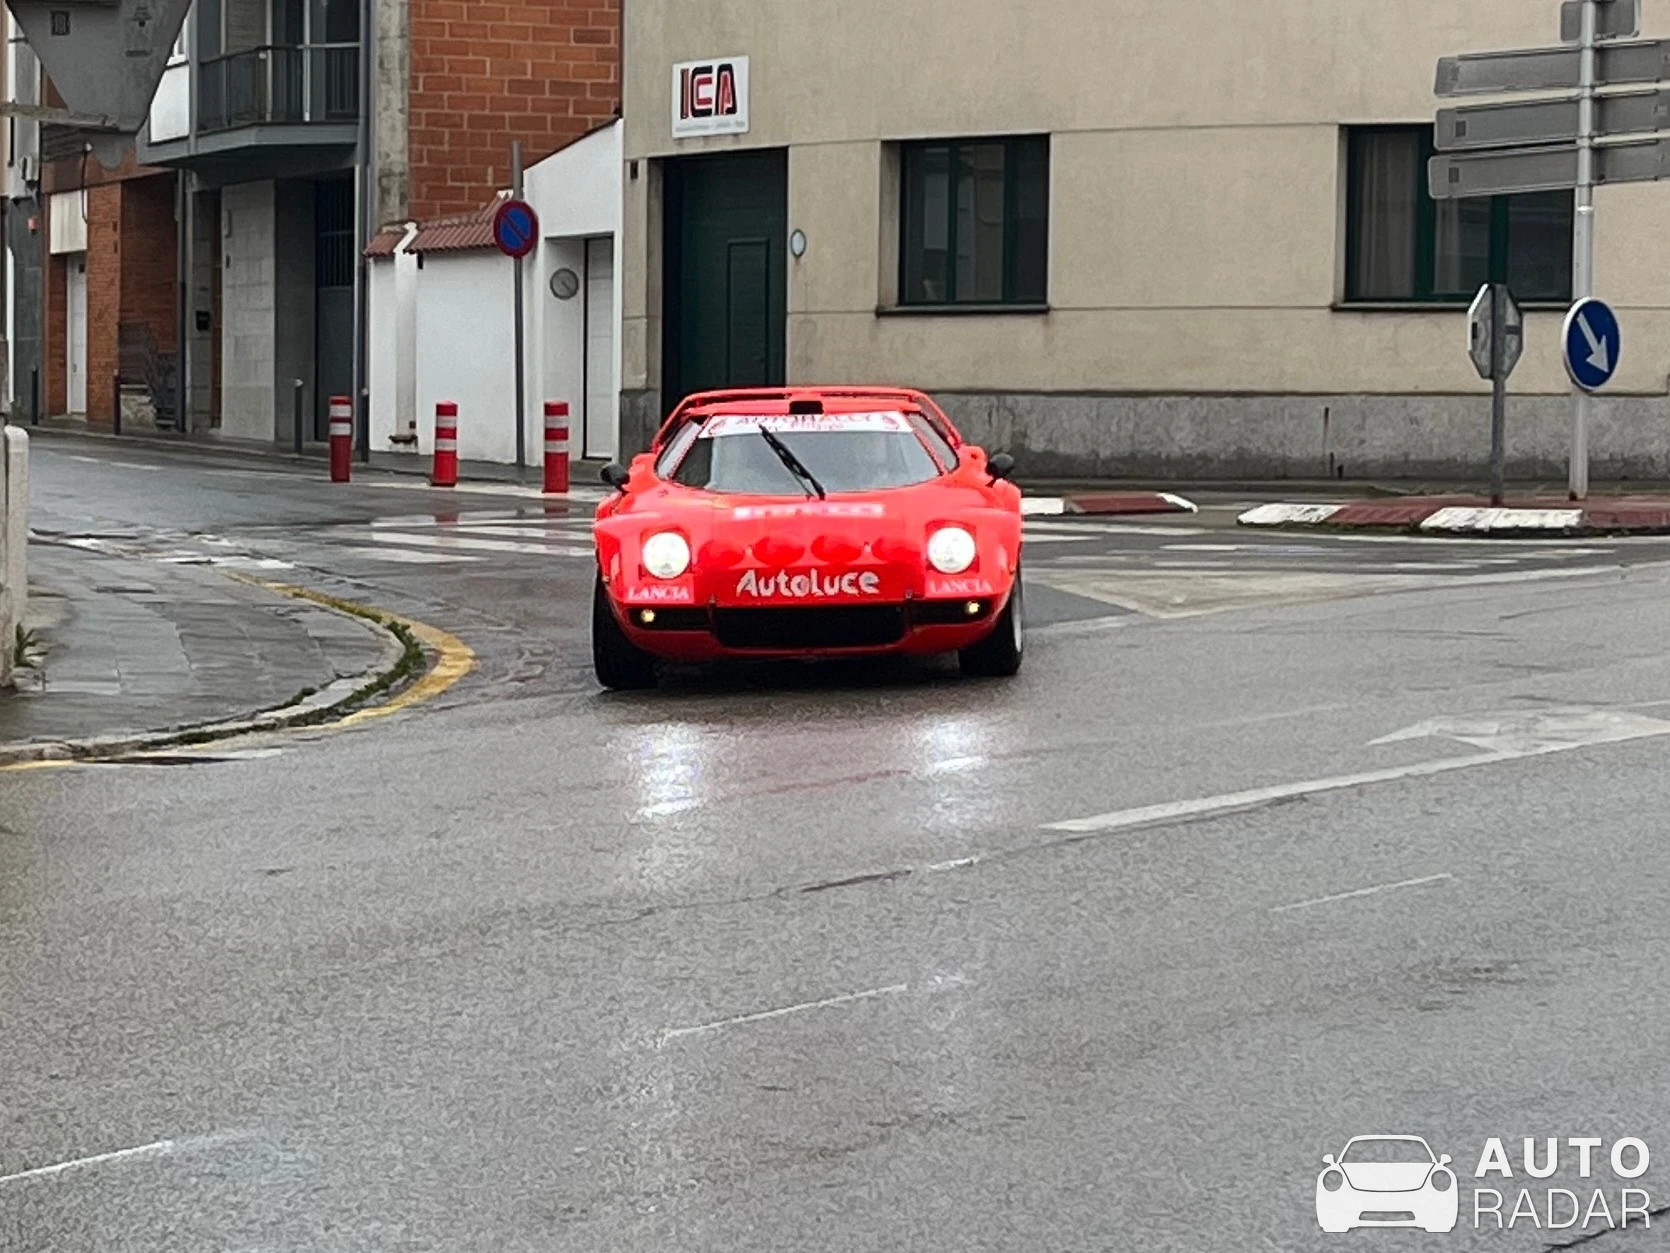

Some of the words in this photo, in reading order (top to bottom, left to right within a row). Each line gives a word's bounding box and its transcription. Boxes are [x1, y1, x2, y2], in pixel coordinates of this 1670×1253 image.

[680, 63, 738, 120] ICA
[627, 584, 690, 601] LANCIA
[735, 568, 881, 598] Autoluce
[929, 578, 993, 594] LANCIA
